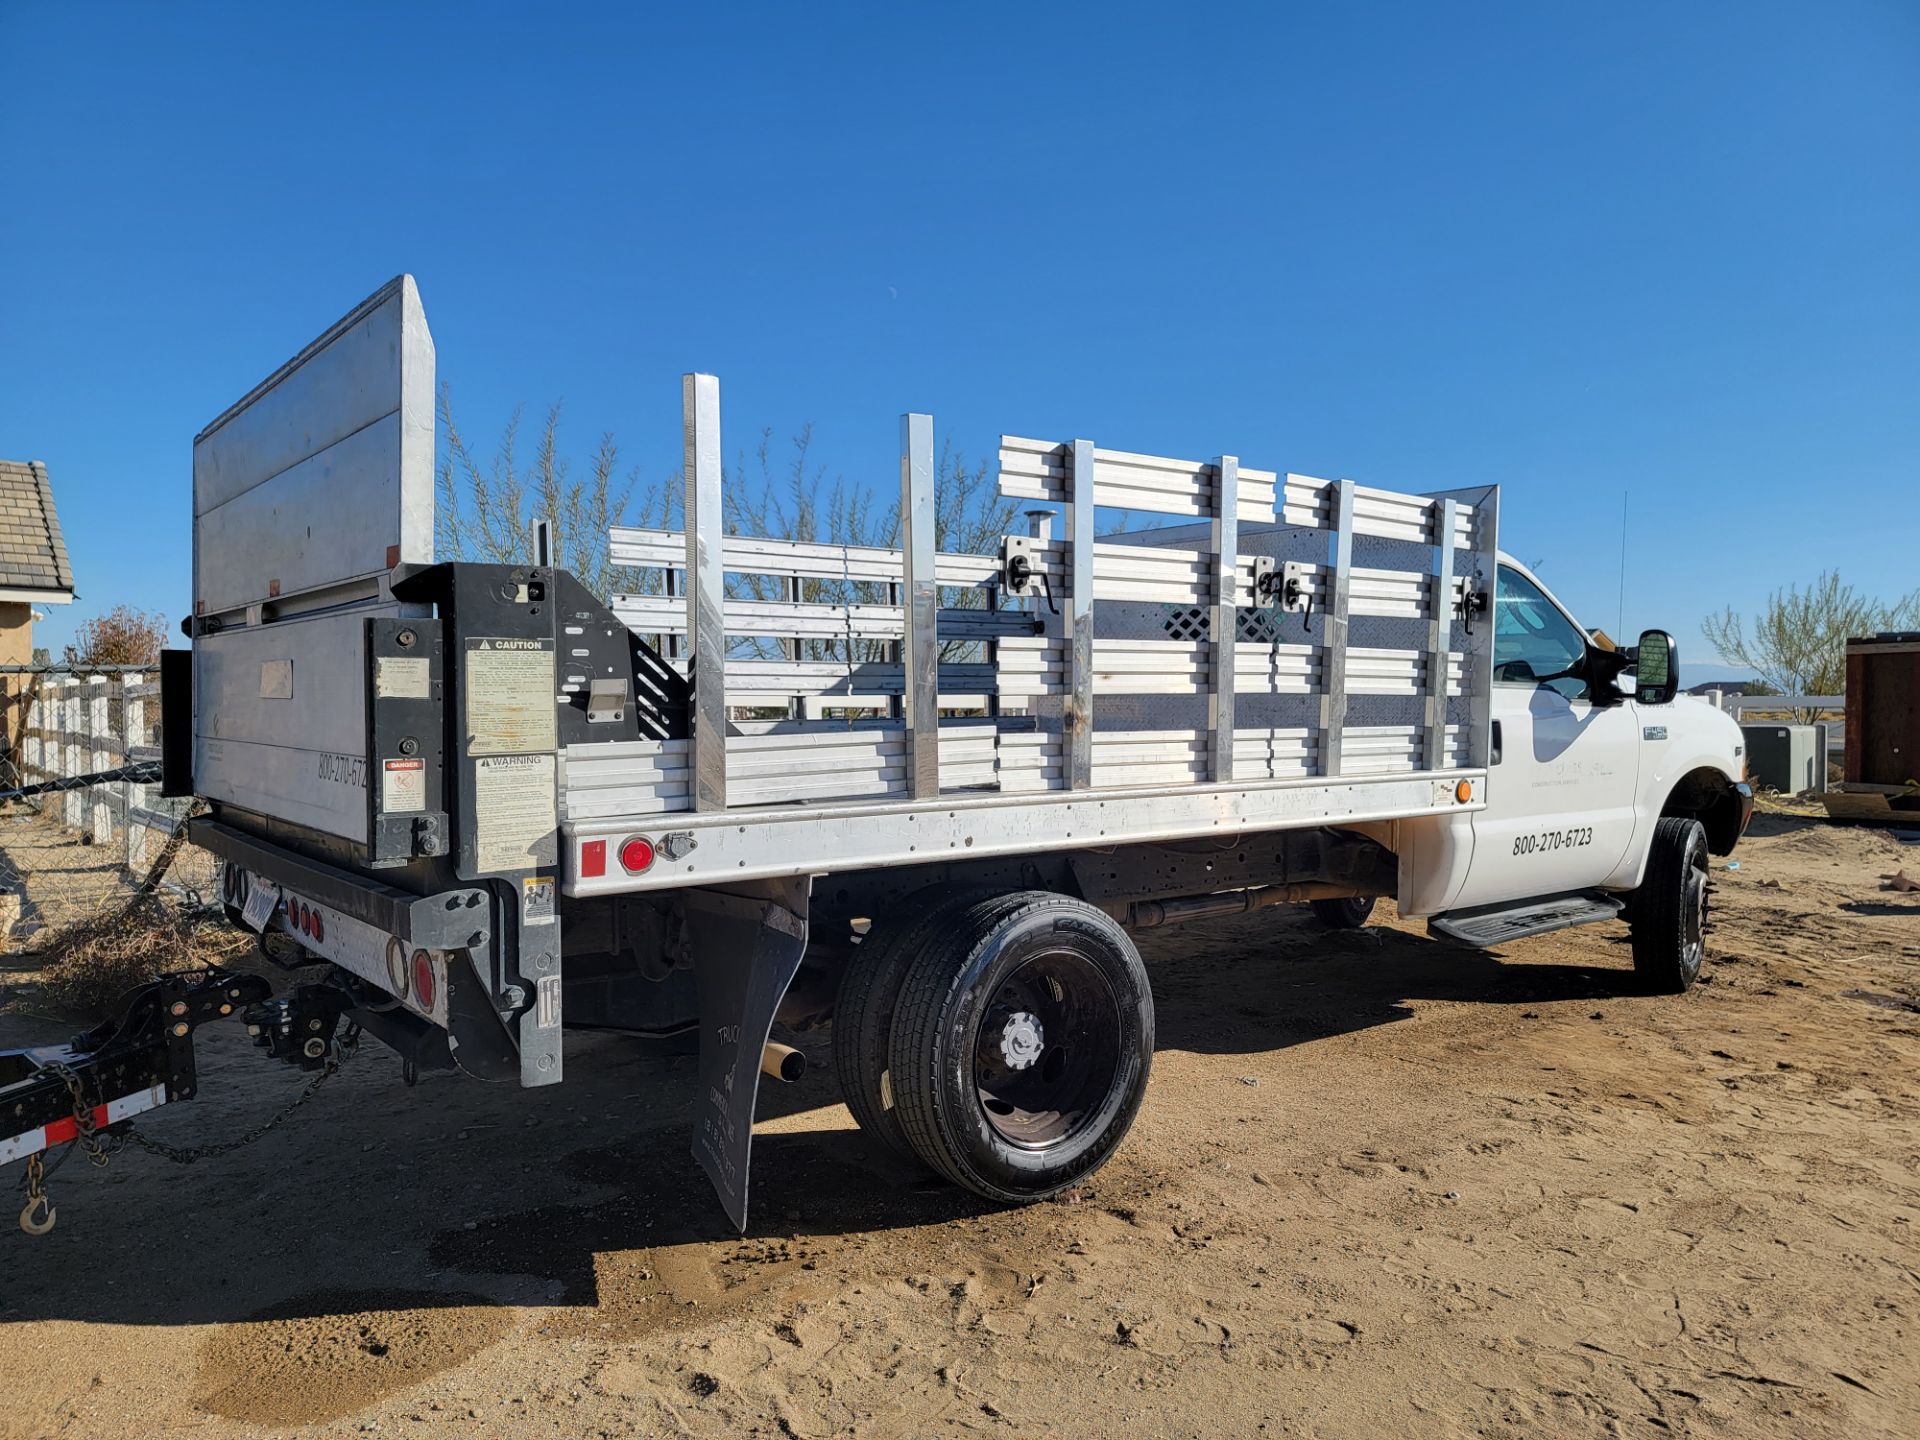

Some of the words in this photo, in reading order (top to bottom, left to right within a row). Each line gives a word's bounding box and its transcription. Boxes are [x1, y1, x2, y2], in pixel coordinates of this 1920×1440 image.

[495, 641, 542, 650] CAUTION
[391, 761, 418, 769] DANGER
[492, 755, 542, 766] WARNING
[1512, 827, 1593, 856] 800-270-6723
